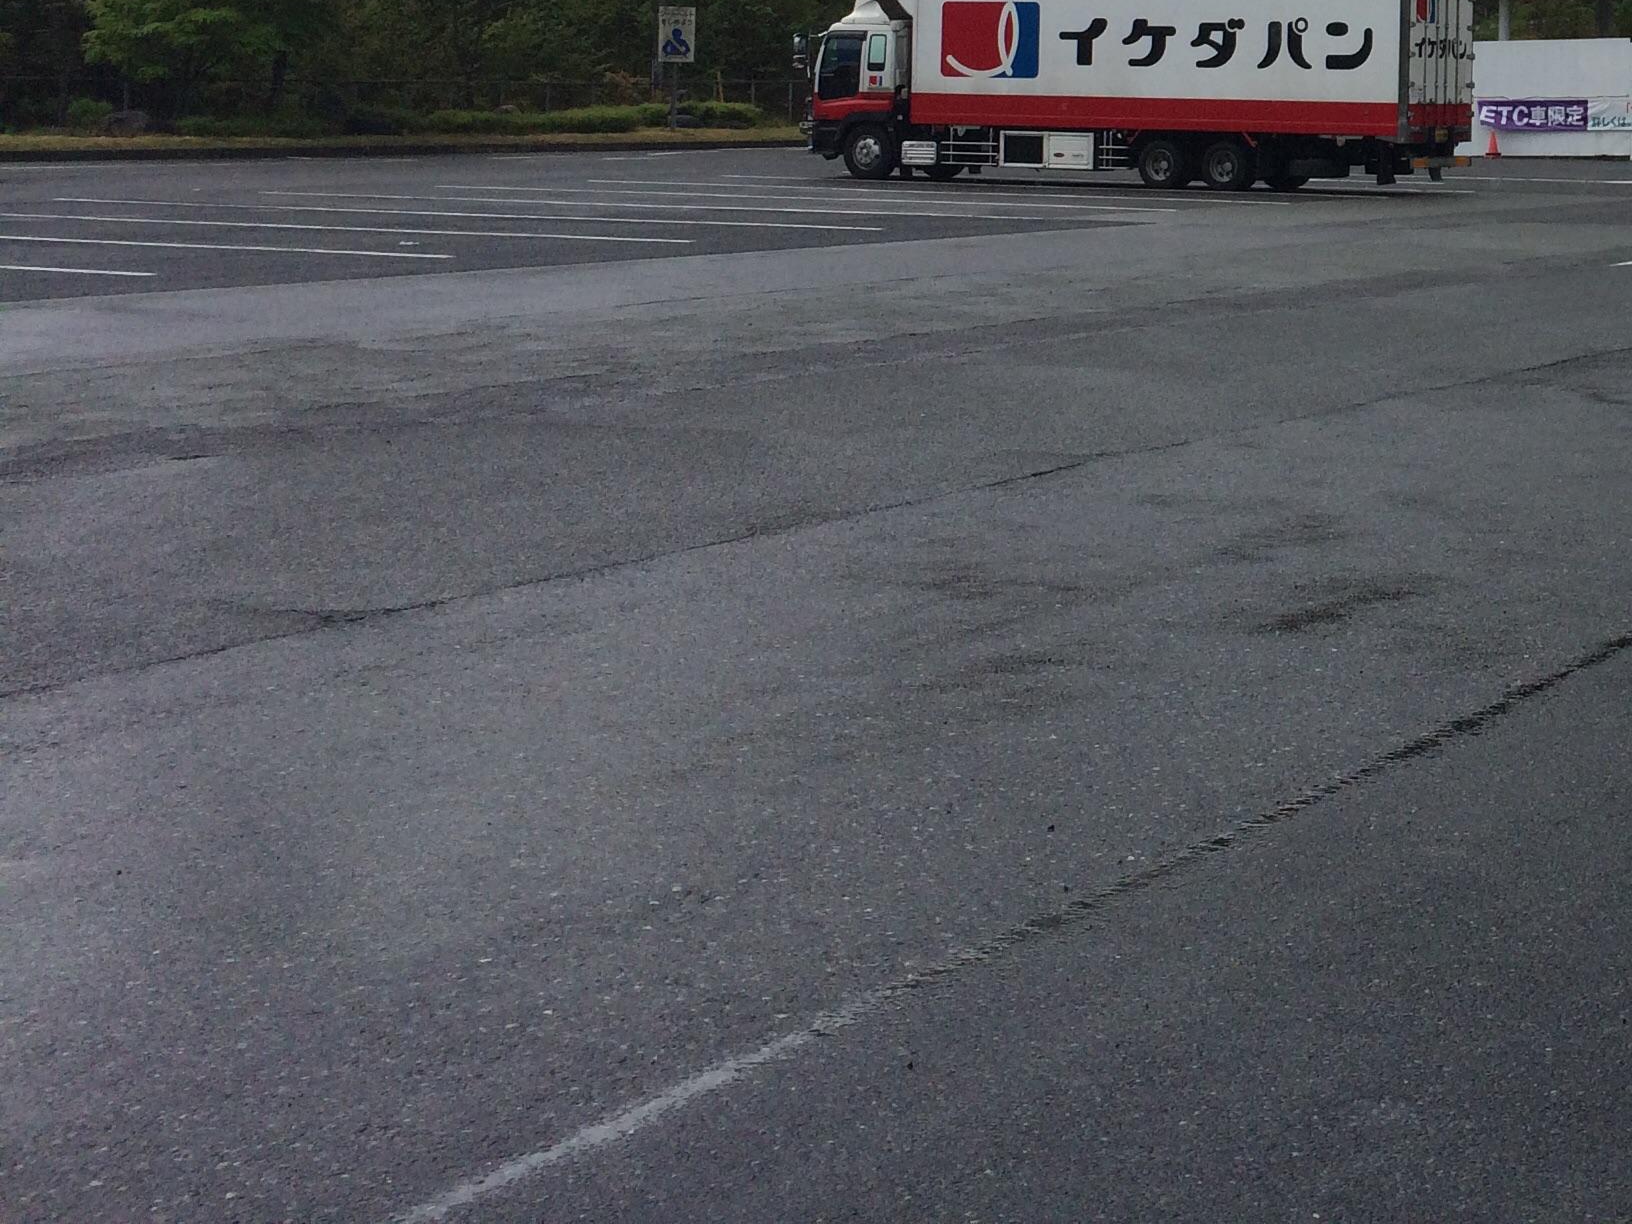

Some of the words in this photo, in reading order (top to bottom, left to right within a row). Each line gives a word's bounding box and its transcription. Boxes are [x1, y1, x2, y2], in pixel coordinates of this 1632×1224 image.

[1058, 16, 1374, 70] イケダパン
[1479, 104, 1585, 127] ETC車限定
